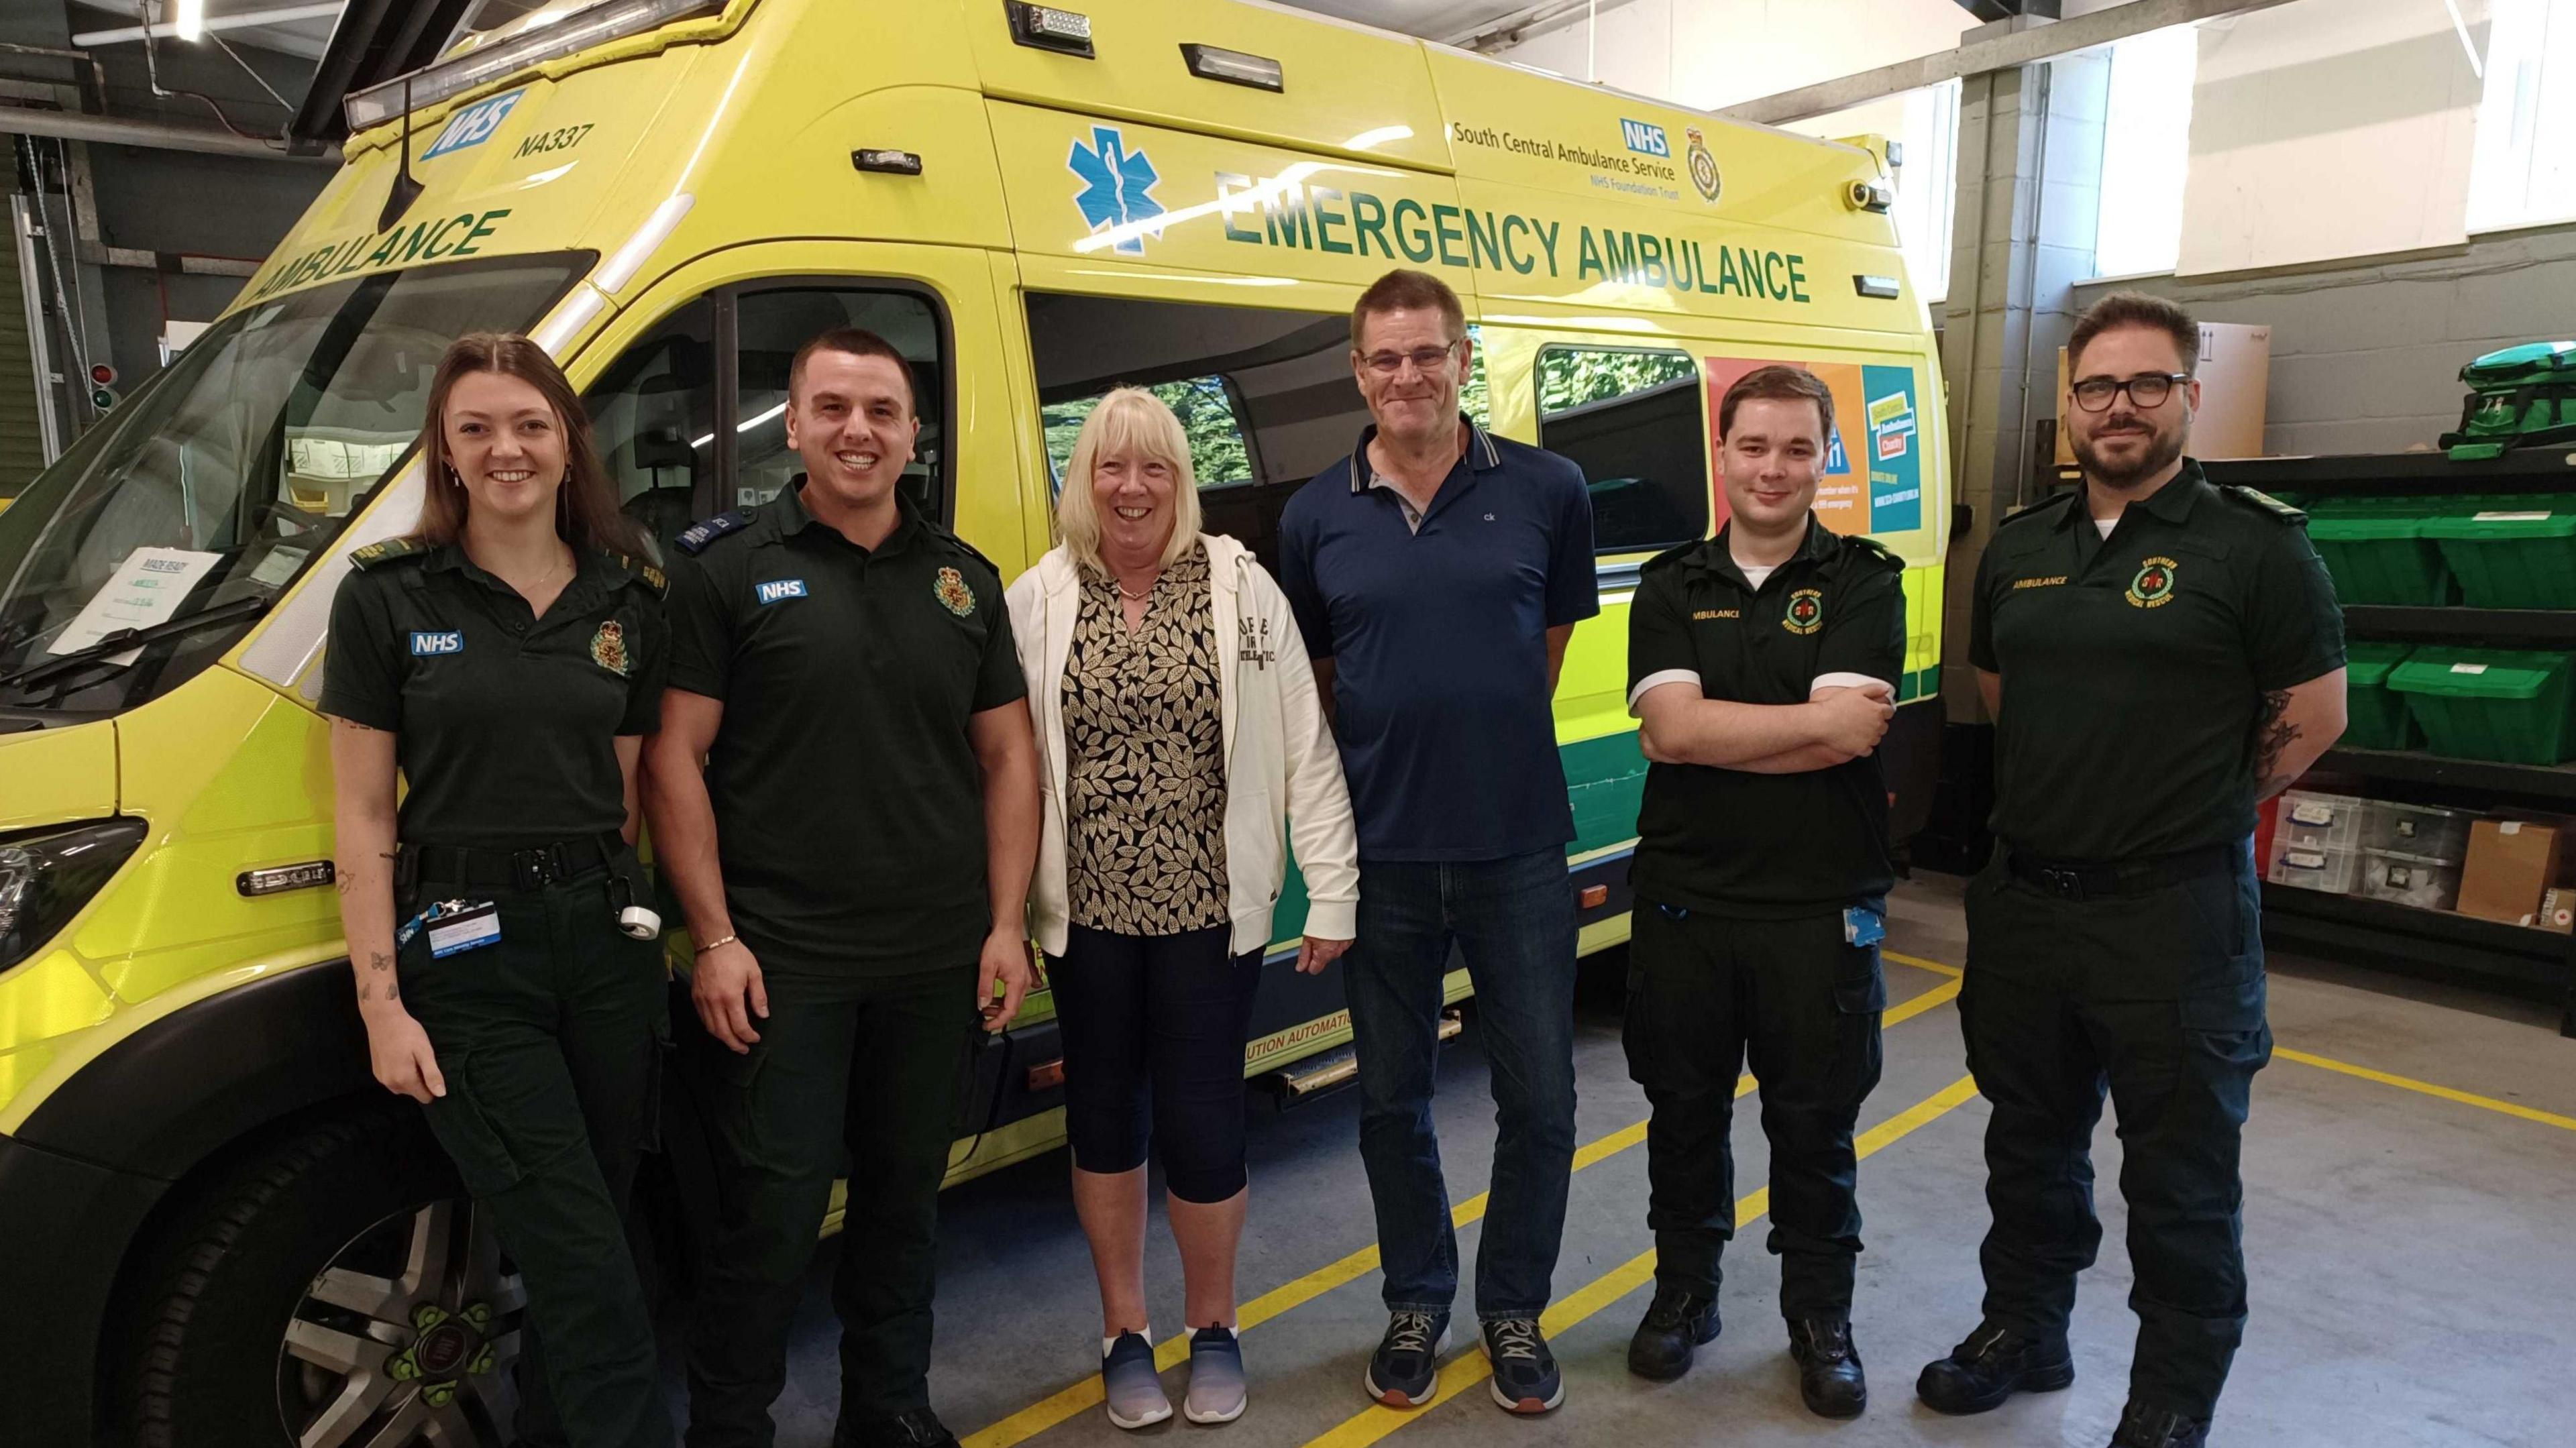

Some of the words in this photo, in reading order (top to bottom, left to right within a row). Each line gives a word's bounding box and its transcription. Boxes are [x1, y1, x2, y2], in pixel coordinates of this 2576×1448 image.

[425, 95, 519, 155] NHS
[513, 123, 595, 160] NA337
[1623, 121, 1666, 155] NHS
[1454, 122, 1499, 148] South
[1503, 132, 1554, 158] Central
[1558, 144, 1629, 173] Ambulance
[1631, 158, 1675, 182] Service
[1591, 175, 1609, 188] NHS
[1610, 178, 1658, 197] Foundation
[1660, 187, 1679, 200] Trust
[254, 209, 512, 299] AMBULANCE
[1215, 172, 1559, 278] EMERGENCY
[1579, 226, 1811, 303] AMBULANCE
[2142, 556, 2178, 570] SOUTHERN
[762, 581, 801, 601] NHS
[2012, 576, 2068, 590] AMBULANCE
[416, 633, 458, 653] NHS
